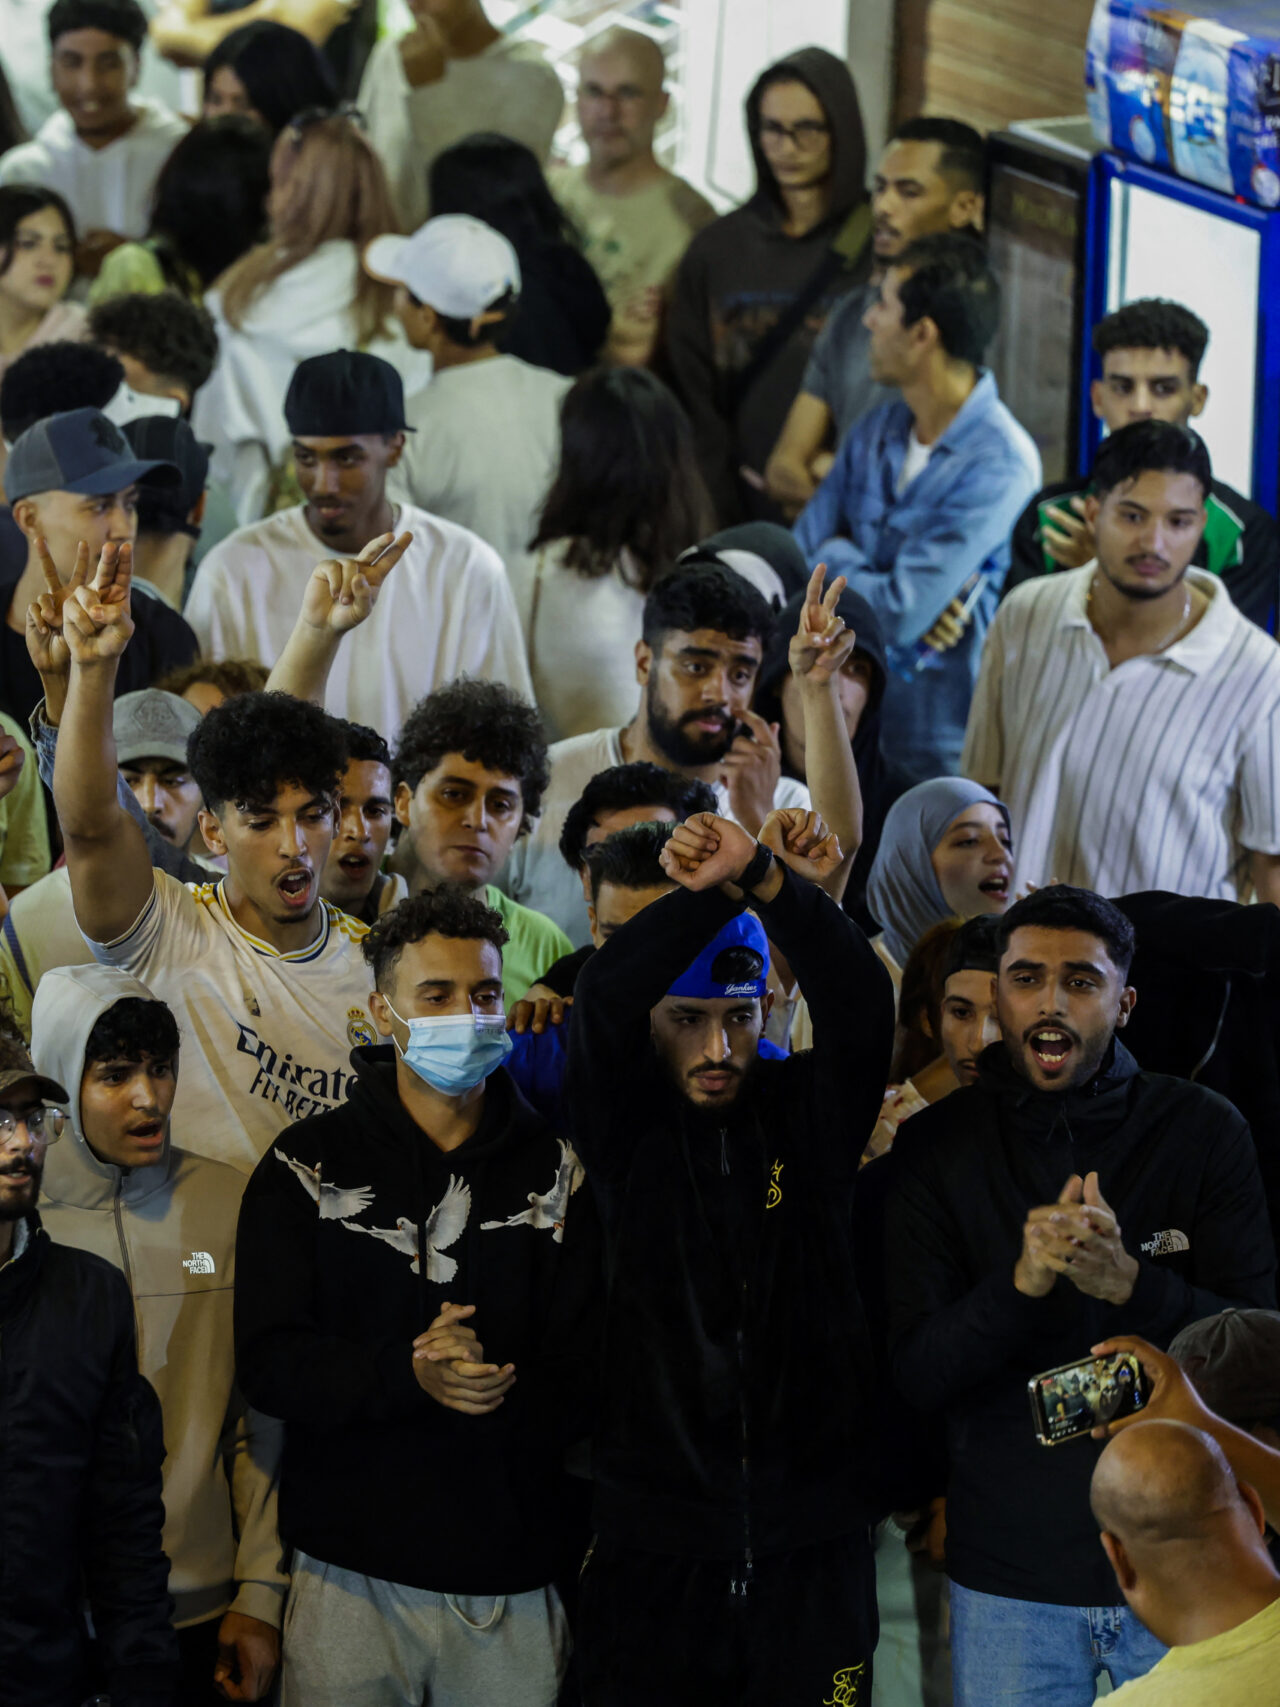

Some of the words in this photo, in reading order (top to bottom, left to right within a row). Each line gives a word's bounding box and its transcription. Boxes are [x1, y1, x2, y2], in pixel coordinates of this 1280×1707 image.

[1152, 1230, 1171, 1241] THE
[1140, 1238, 1172, 1251] NORTH
[191, 1251, 205, 1260] THE
[1150, 1245, 1174, 1257] FACE
